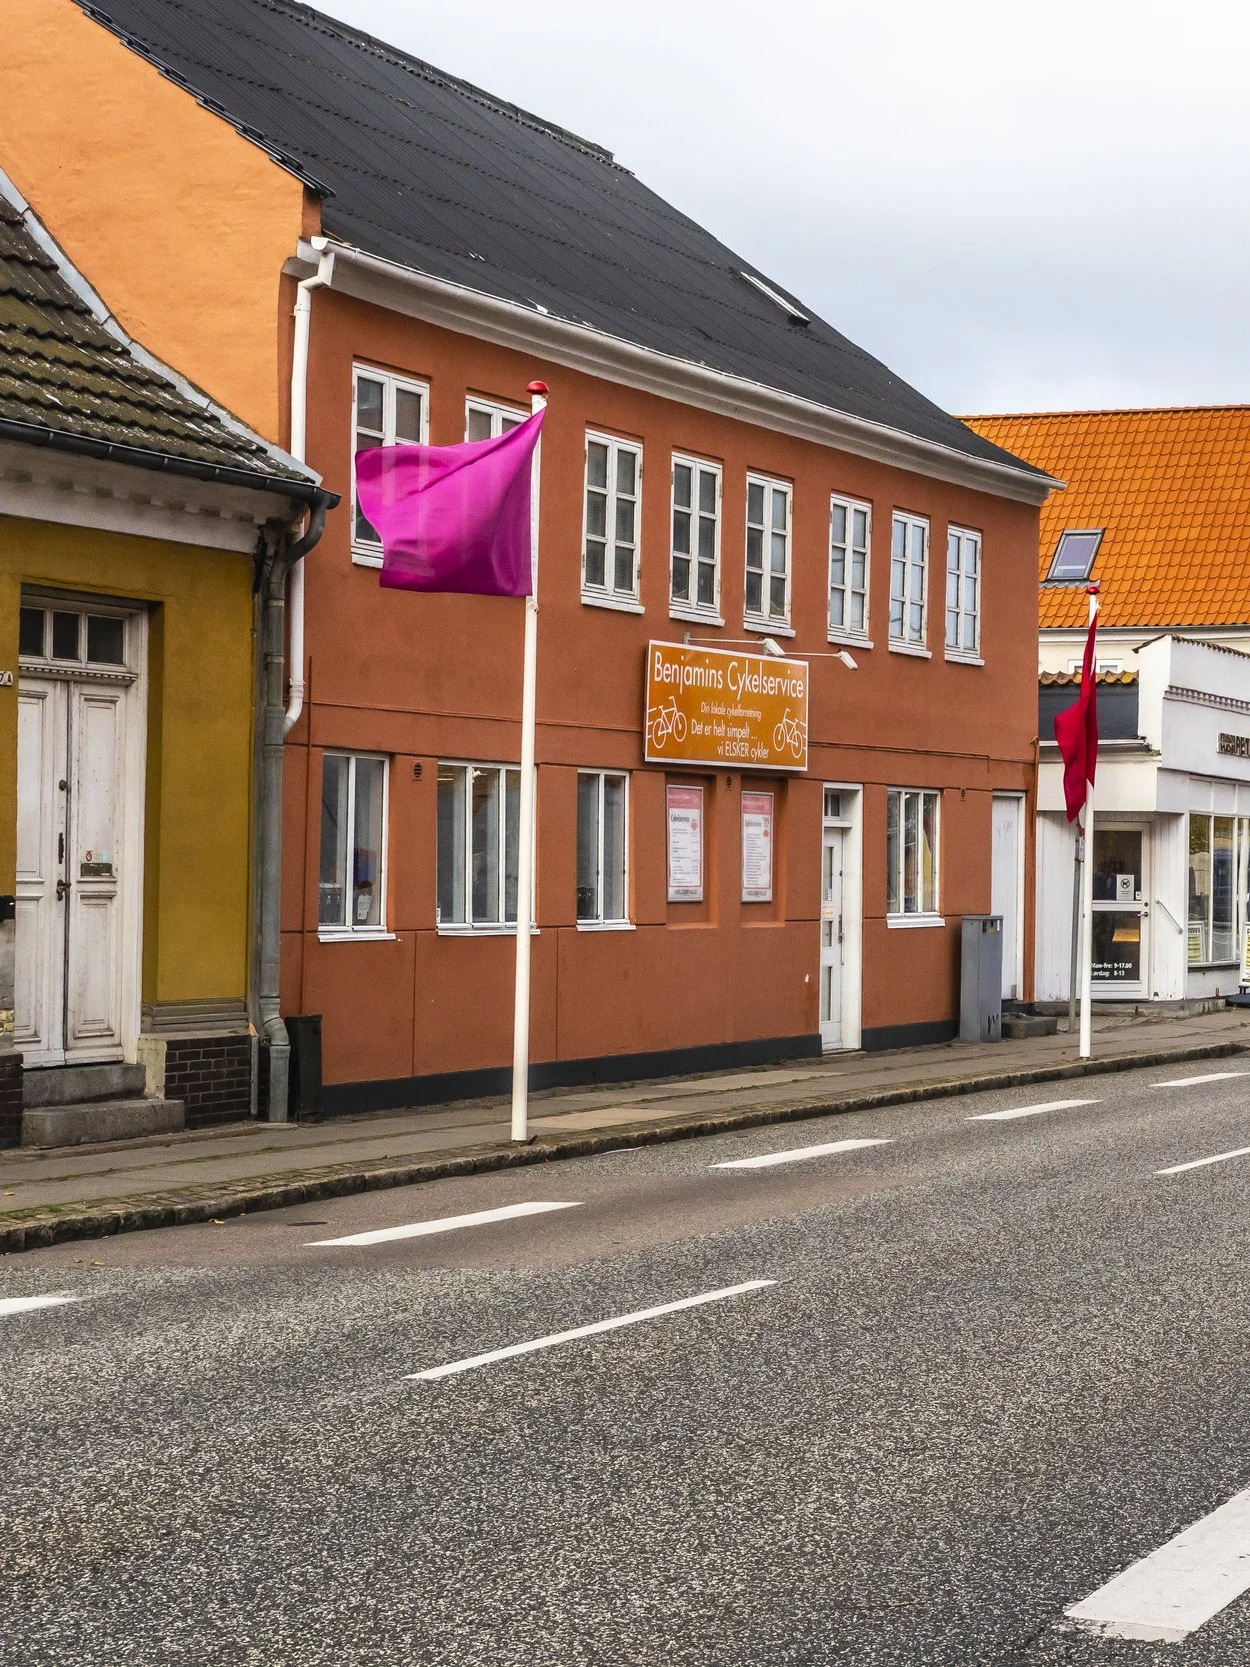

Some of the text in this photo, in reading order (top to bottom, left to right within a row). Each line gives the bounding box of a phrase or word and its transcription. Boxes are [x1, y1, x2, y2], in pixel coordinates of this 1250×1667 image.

[654, 651, 804, 701] Benjamins Cykelservice
[700, 701, 762, 721] Din lokale cykelforretning
[691, 719, 703, 735] Det
[704, 725, 712, 736] er
[713, 719, 726, 737] helt
[727, 721, 750, 743] simpelt
[717, 741, 769, 762] vi ELSKER cykler
